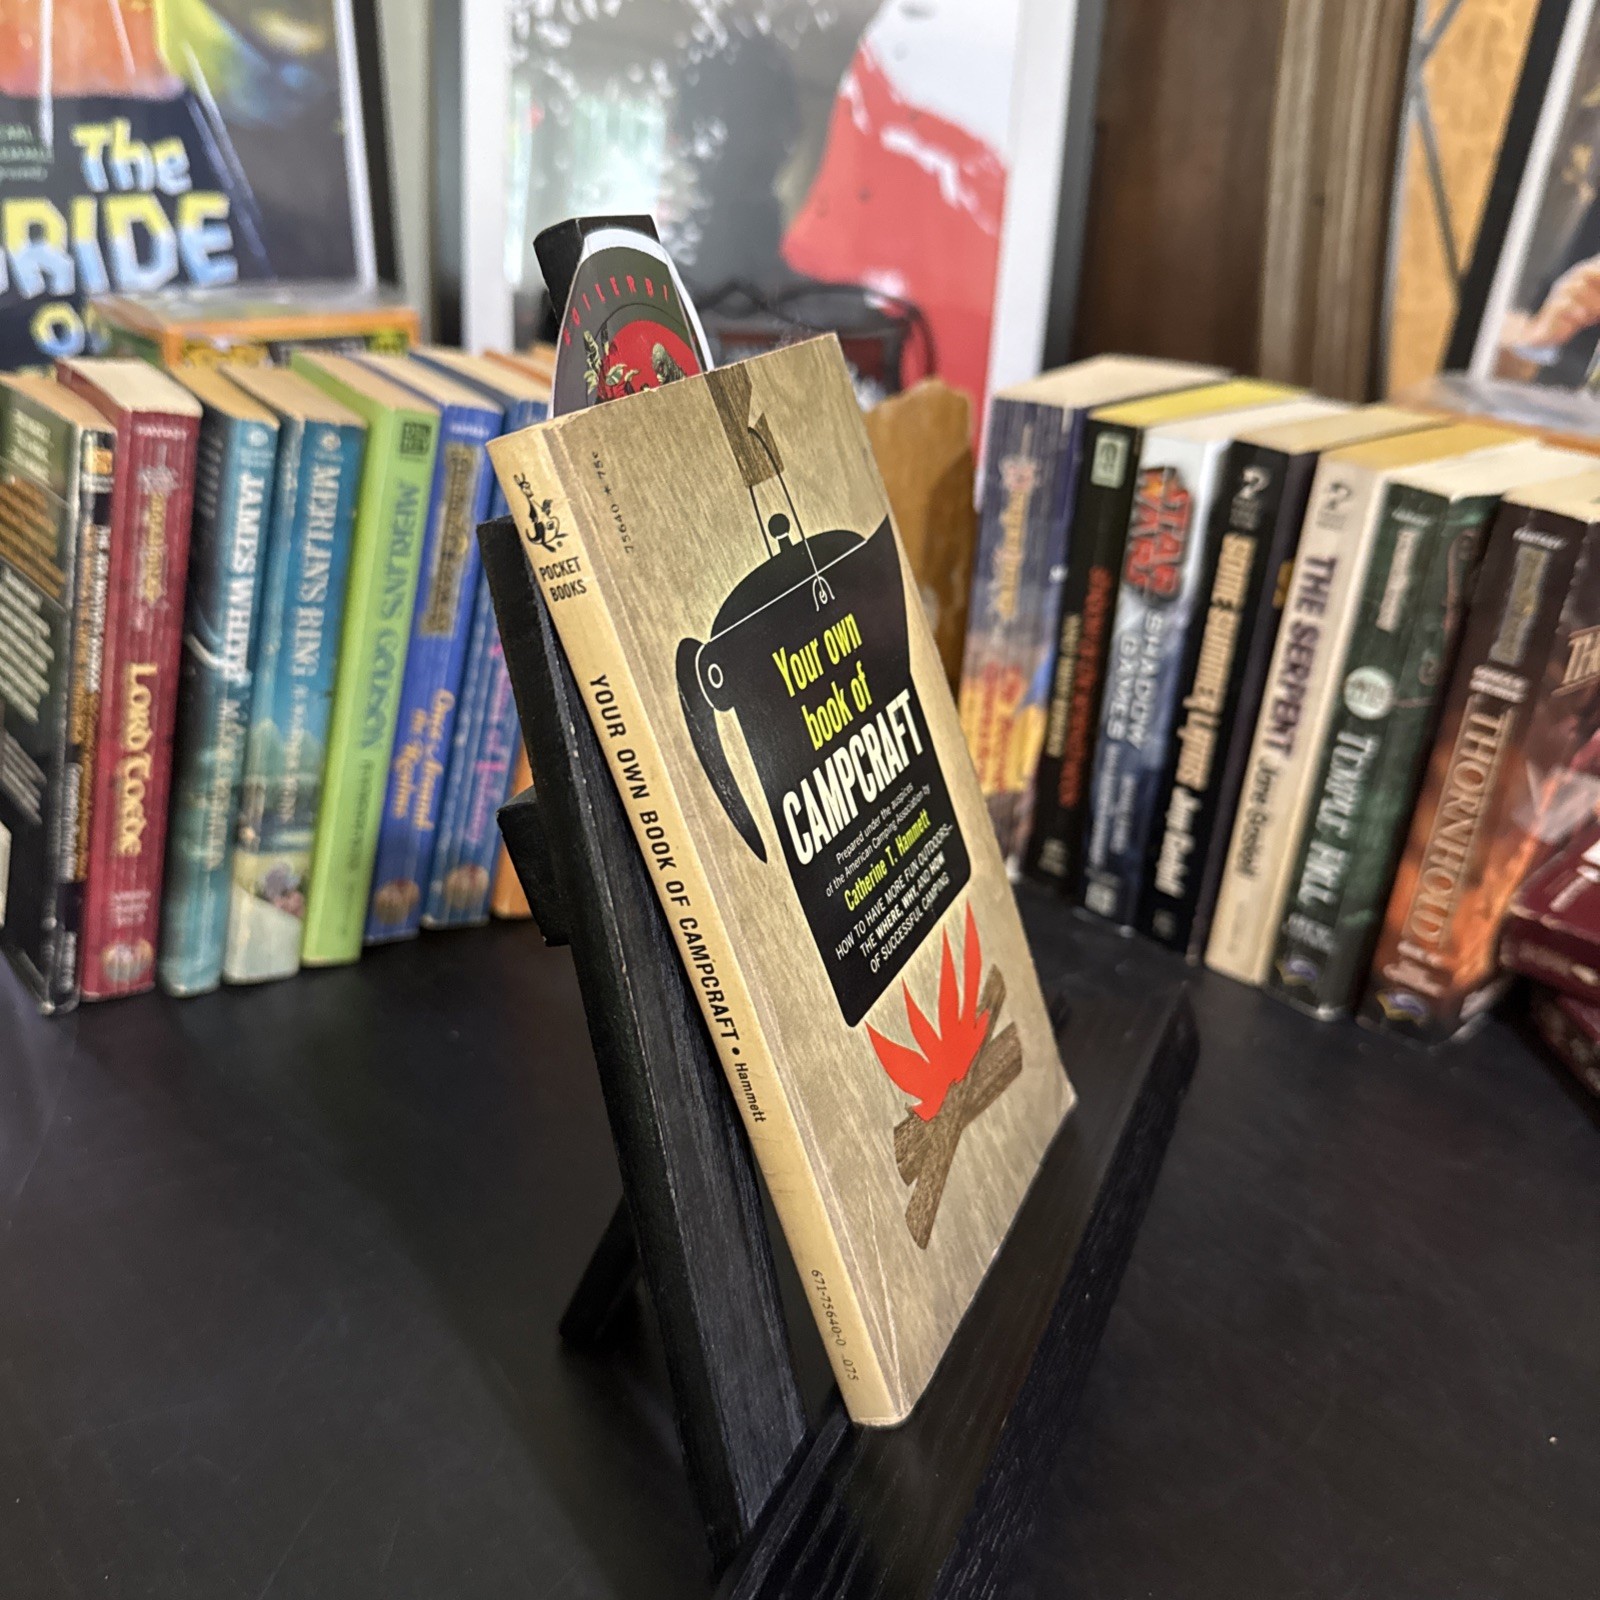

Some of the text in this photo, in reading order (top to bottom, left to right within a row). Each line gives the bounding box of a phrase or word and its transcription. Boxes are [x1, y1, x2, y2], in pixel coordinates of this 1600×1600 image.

[70, 116, 192, 196] The
[0, 190, 238, 300] RIDE
[231, 473, 266, 574] JAMES
[539, 556, 582, 582] POCKET
[611, 503, 634, 554] 75640
[1124, 468, 1166, 588] WARS
[1147, 485, 1194, 597] STAR
[550, 579, 587, 602] BOOKS
[1296, 555, 1338, 618] THE
[291, 606, 325, 678] RING
[772, 613, 862, 697] Your own
[1263, 620, 1321, 763] SERPENT
[801, 660, 872, 751] book of
[782, 688, 923, 865] CAMPCRAFT
[589, 674, 740, 1041] YOUR OWN BOOK OF CAMPCRAFT
[826, 882, 834, 897] of
[833, 873, 846, 890] the
[844, 845, 874, 878] American
[872, 820, 898, 849] Camping
[836, 830, 865, 865] Prepared
[863, 815, 881, 838] under
[880, 806, 892, 820] the
[844, 808, 931, 912] Catherine T. Hammett
[1409, 711, 1503, 944] THORNHOLD
[834, 931, 854, 961] HOW
[853, 919, 866, 940] TO
[864, 897, 887, 927] HAVE
[884, 877, 907, 906] MORE
[903, 859, 920, 883] FUN
[859, 932, 878, 957] THE
[875, 905, 905, 942] WHERE,
[917, 868, 932, 891] AND
[930, 851, 946, 874] HOW
[869, 871, 950, 974] OF SUCCESSFUL CAMPING
[734, 1062, 767, 1123] Hammett
